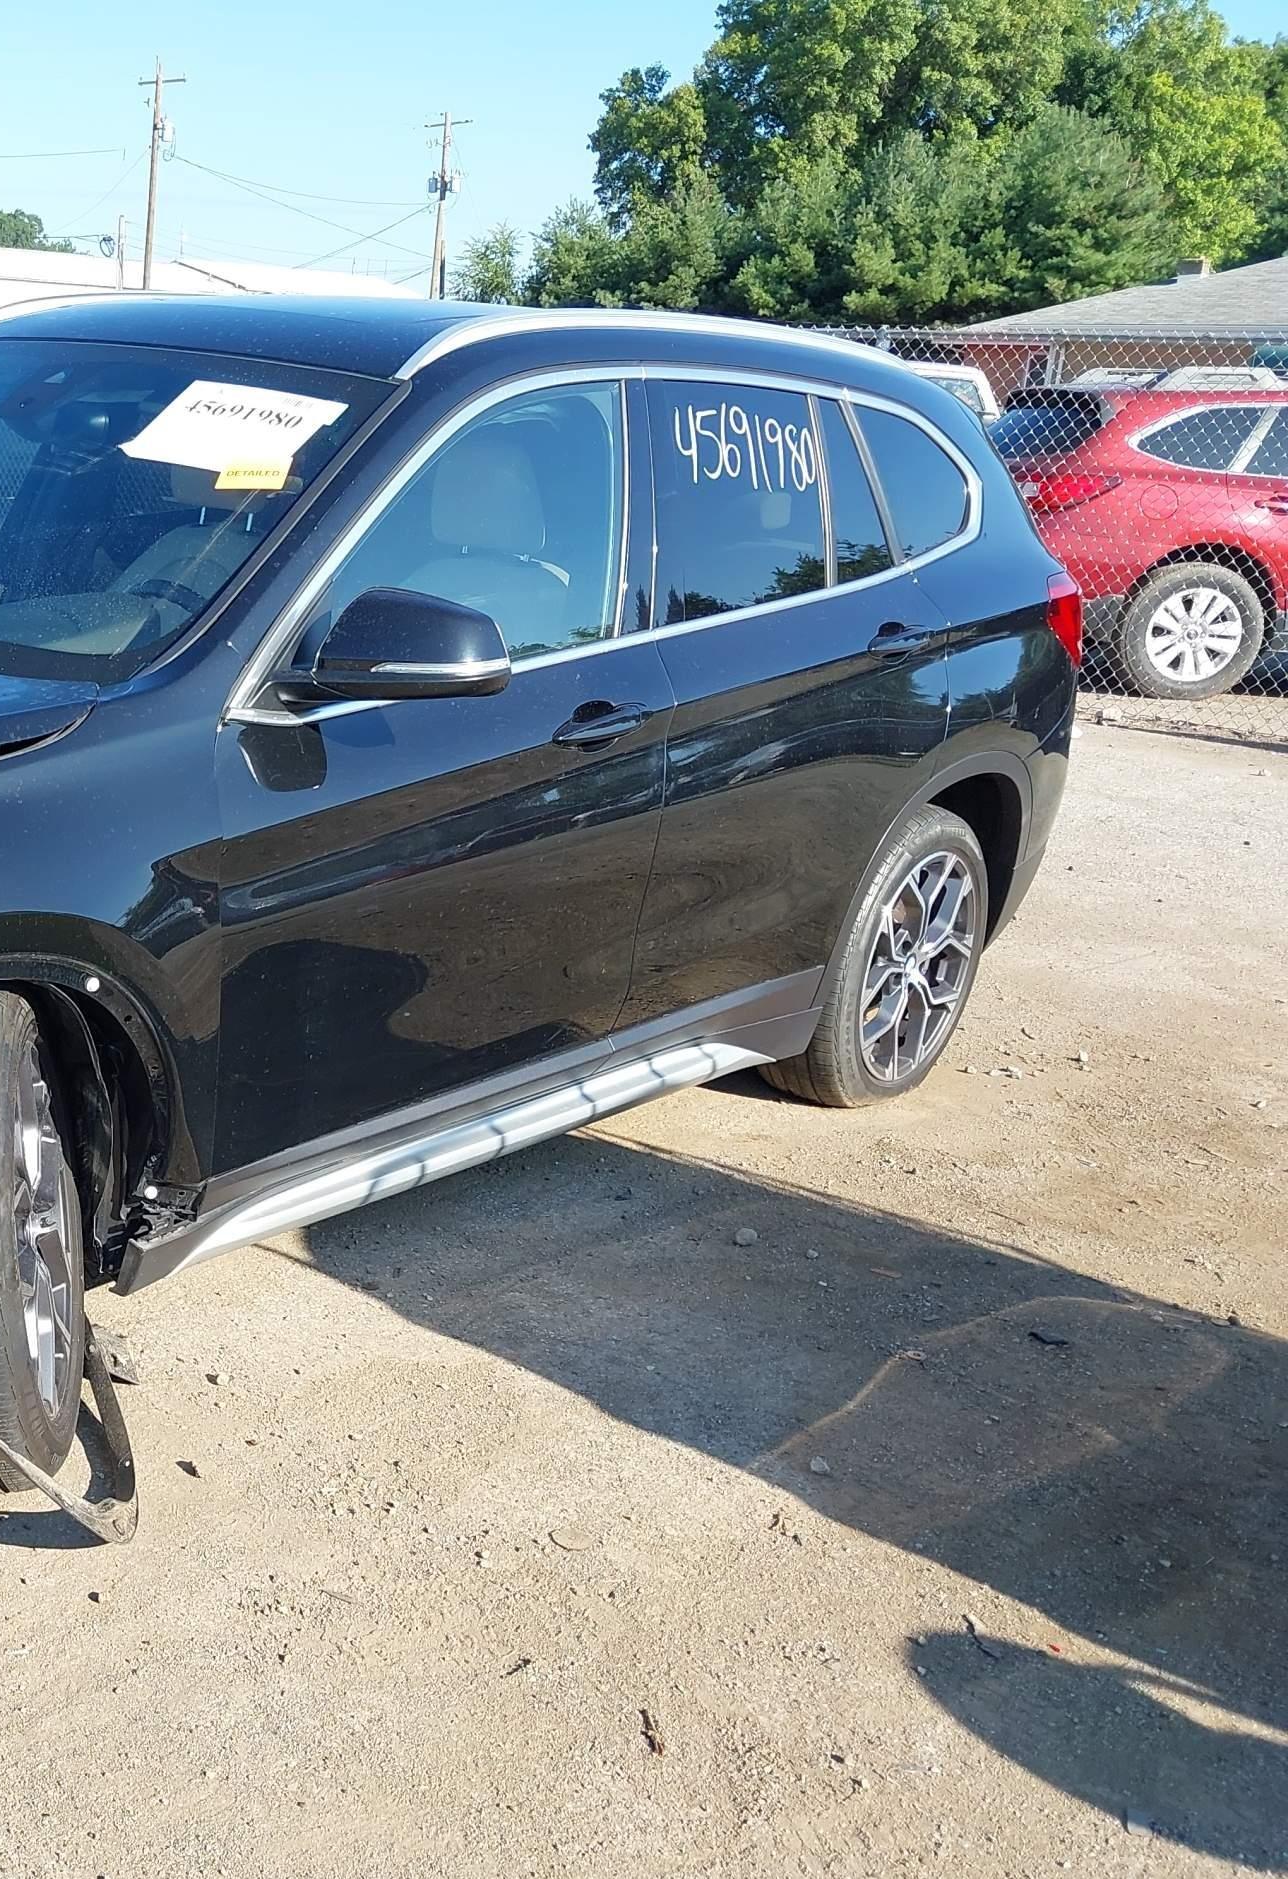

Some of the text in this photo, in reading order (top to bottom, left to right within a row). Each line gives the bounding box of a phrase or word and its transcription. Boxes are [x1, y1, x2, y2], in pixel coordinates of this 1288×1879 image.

[185, 399, 304, 429] 45691980
[674, 402, 816, 493] 45691980
[226, 469, 281, 478] DETAILED
